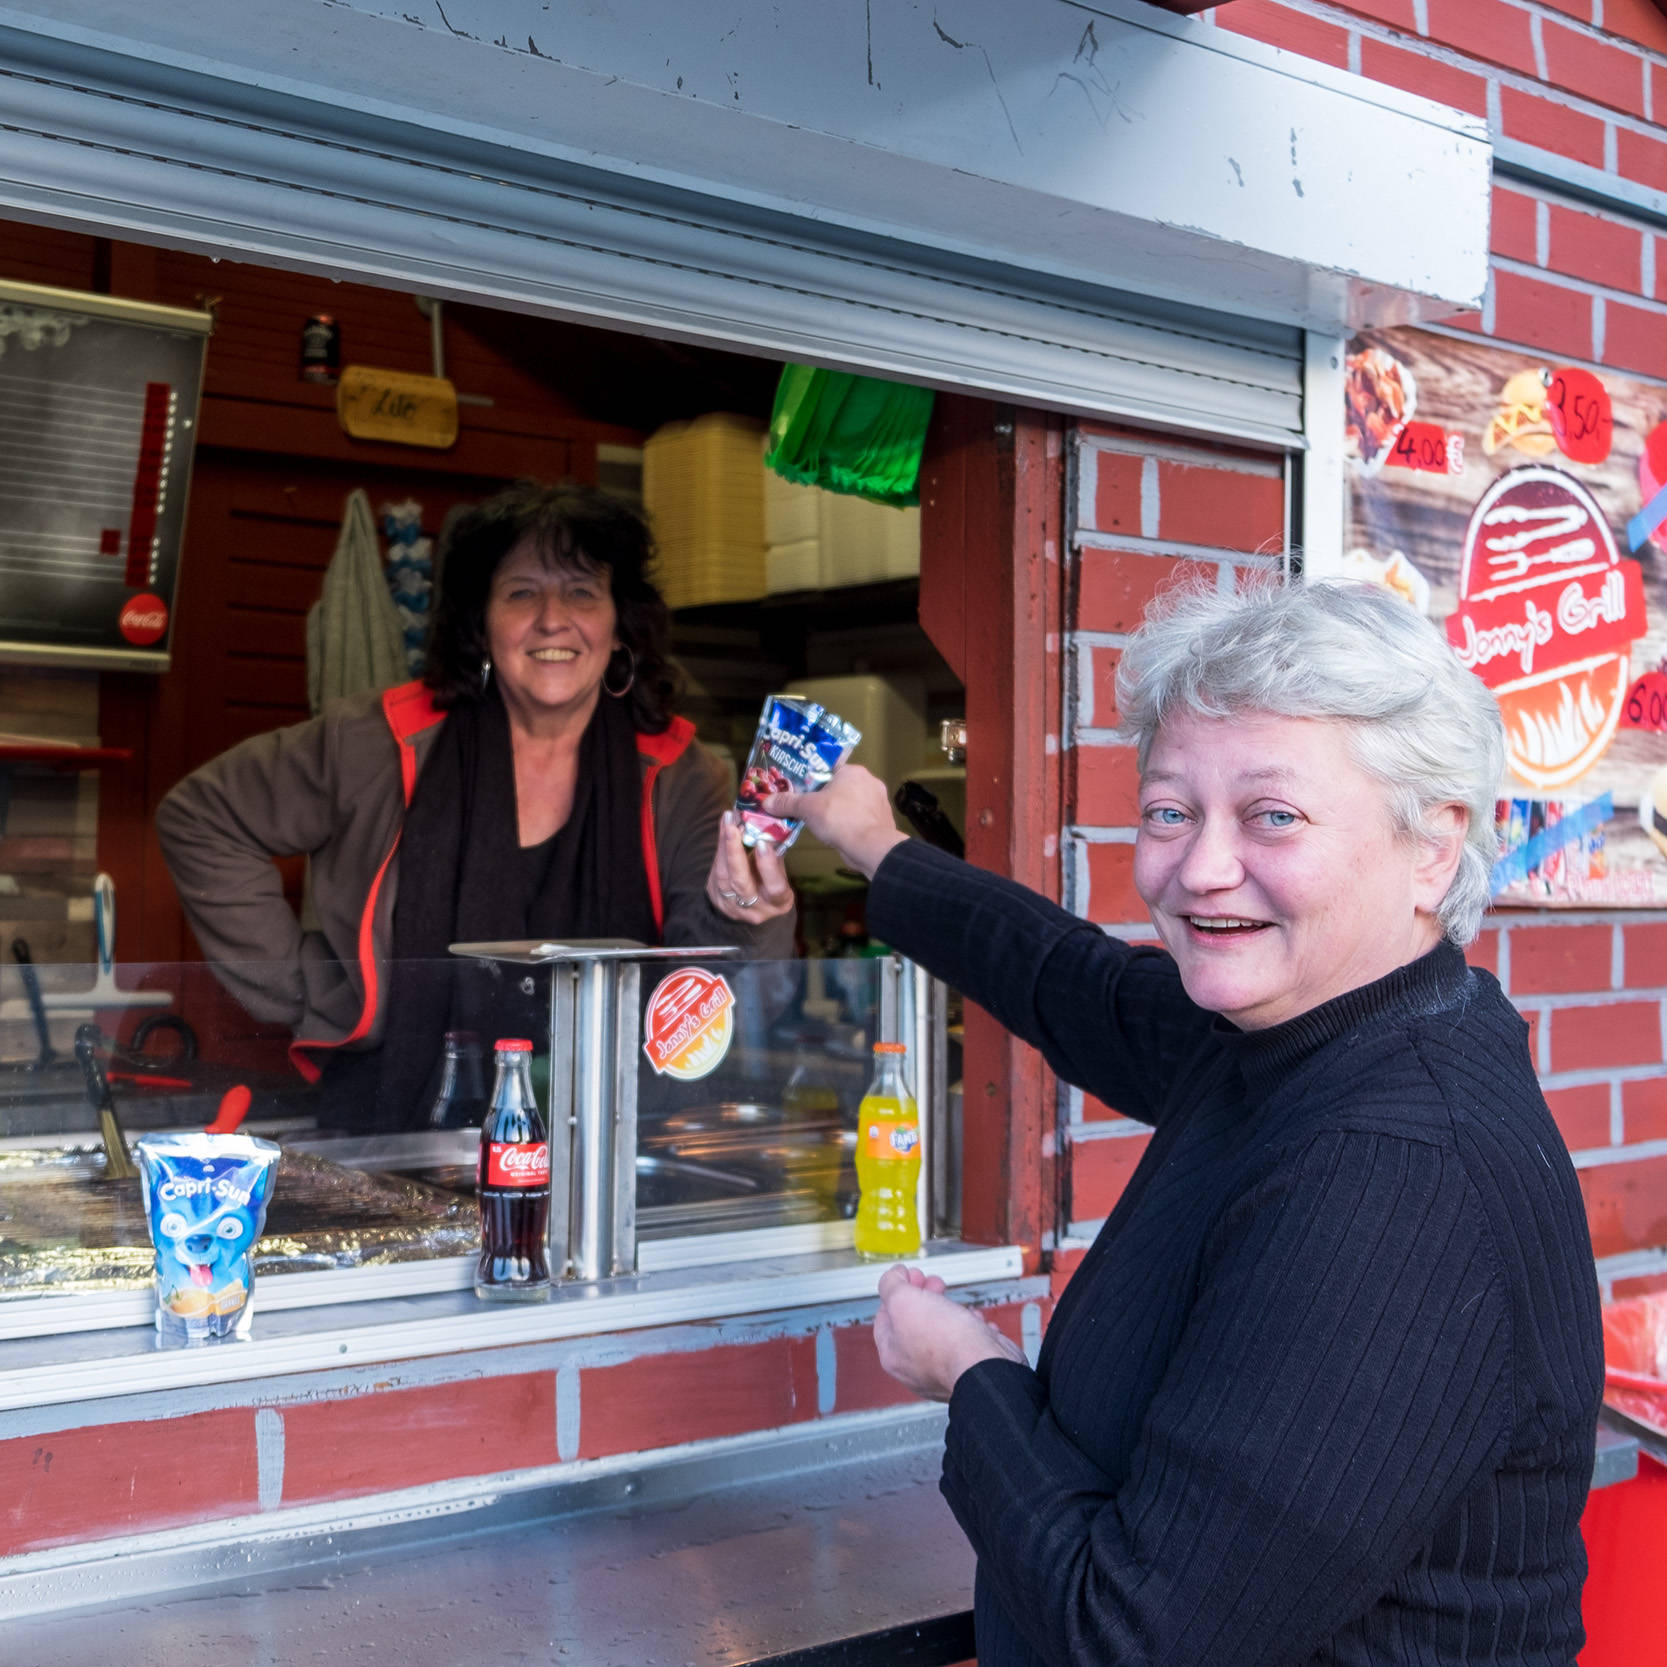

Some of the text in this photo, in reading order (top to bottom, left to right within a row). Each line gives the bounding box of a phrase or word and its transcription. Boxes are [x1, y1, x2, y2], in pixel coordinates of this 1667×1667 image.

[1454, 569, 1627, 675] Jonny's Grill
[769, 744, 808, 778] KIRSCHE
[655, 988, 729, 1060] Jonny's Grill
[159, 1177, 252, 1206] Capri-Sun
